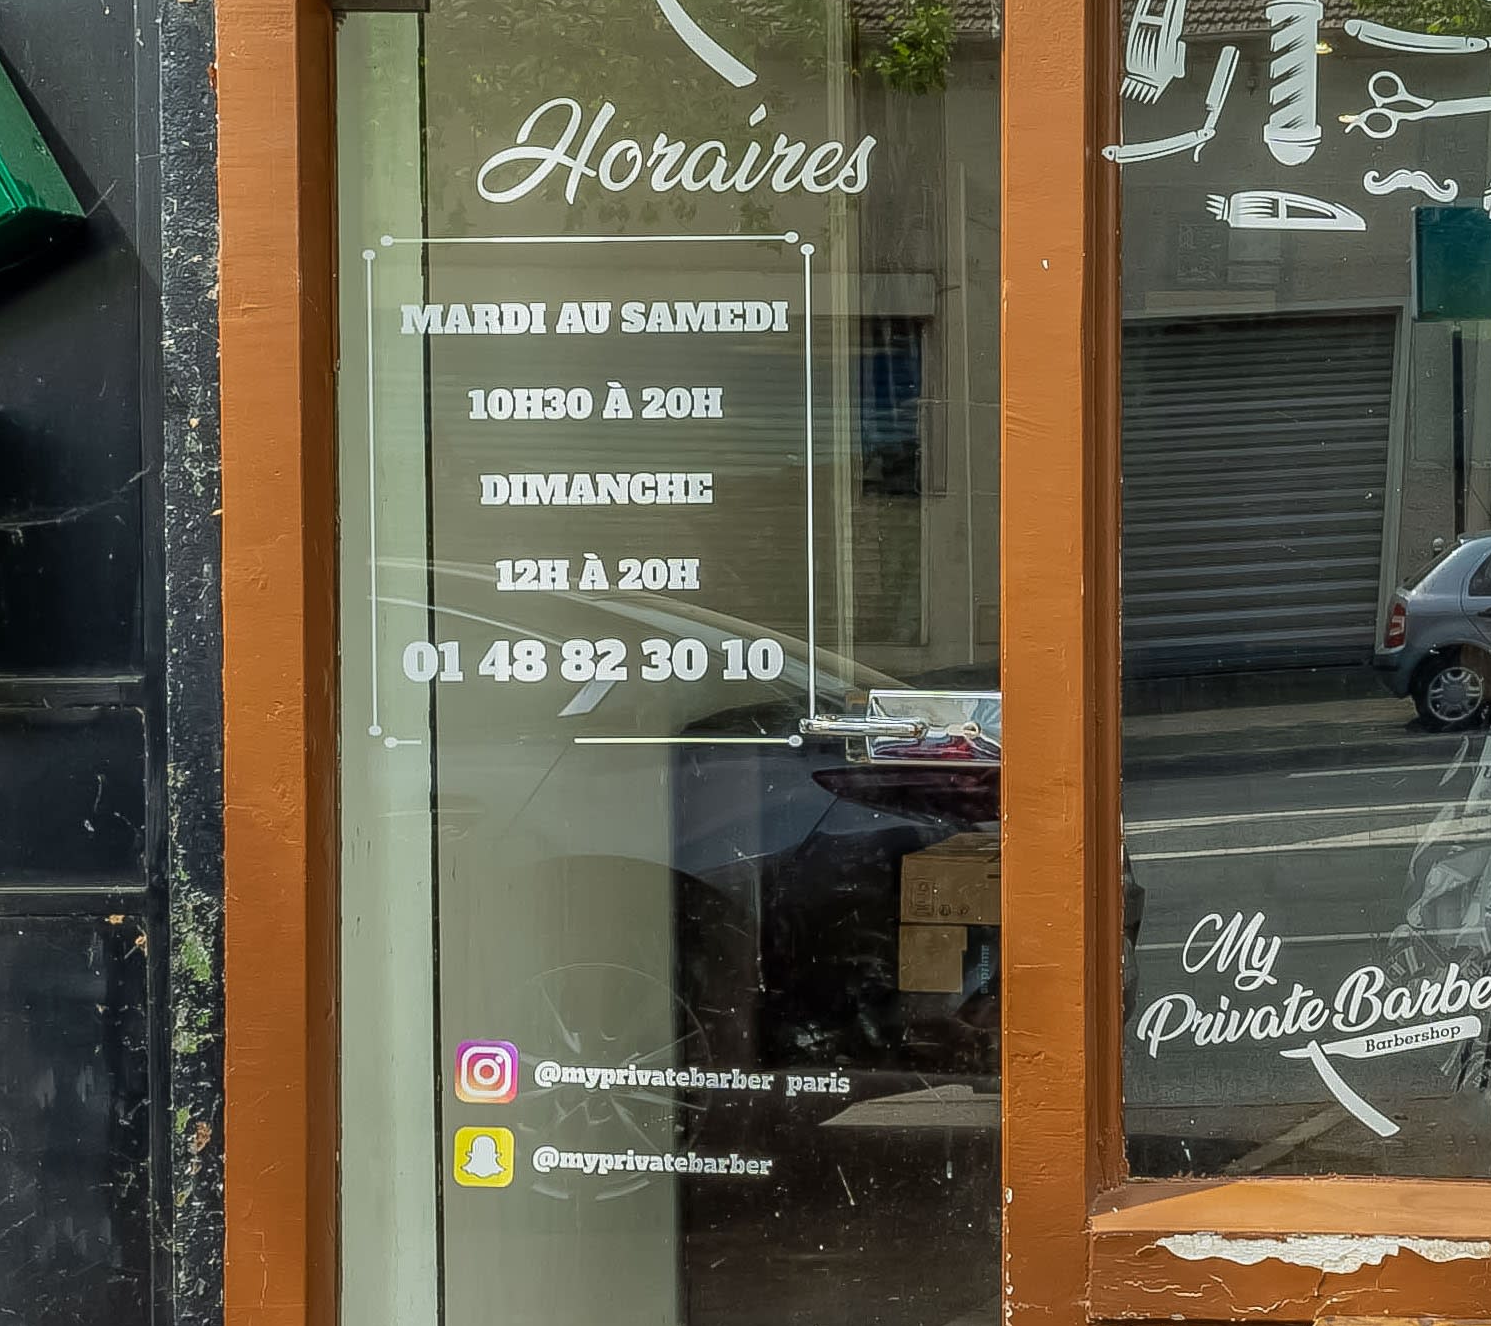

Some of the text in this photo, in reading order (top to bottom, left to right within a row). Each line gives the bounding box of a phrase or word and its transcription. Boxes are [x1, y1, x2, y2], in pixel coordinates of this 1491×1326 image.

[477, 97, 878, 205] Horaires
[401, 301, 789, 335] MARDI AU SAMEDI
[468, 380, 724, 420] 10H30 À 20H
[480, 472, 714, 505] DIMANCHE
[495, 552, 700, 591] 12H À 20H
[402, 637, 786, 683] 01 48 82 30 10
[1181, 911, 1281, 992] My
[1137, 986, 1330, 1059] Private
[1364, 1023, 1461, 1056] Barbershop
[532, 1145, 773, 1177] @myprivatebarber
